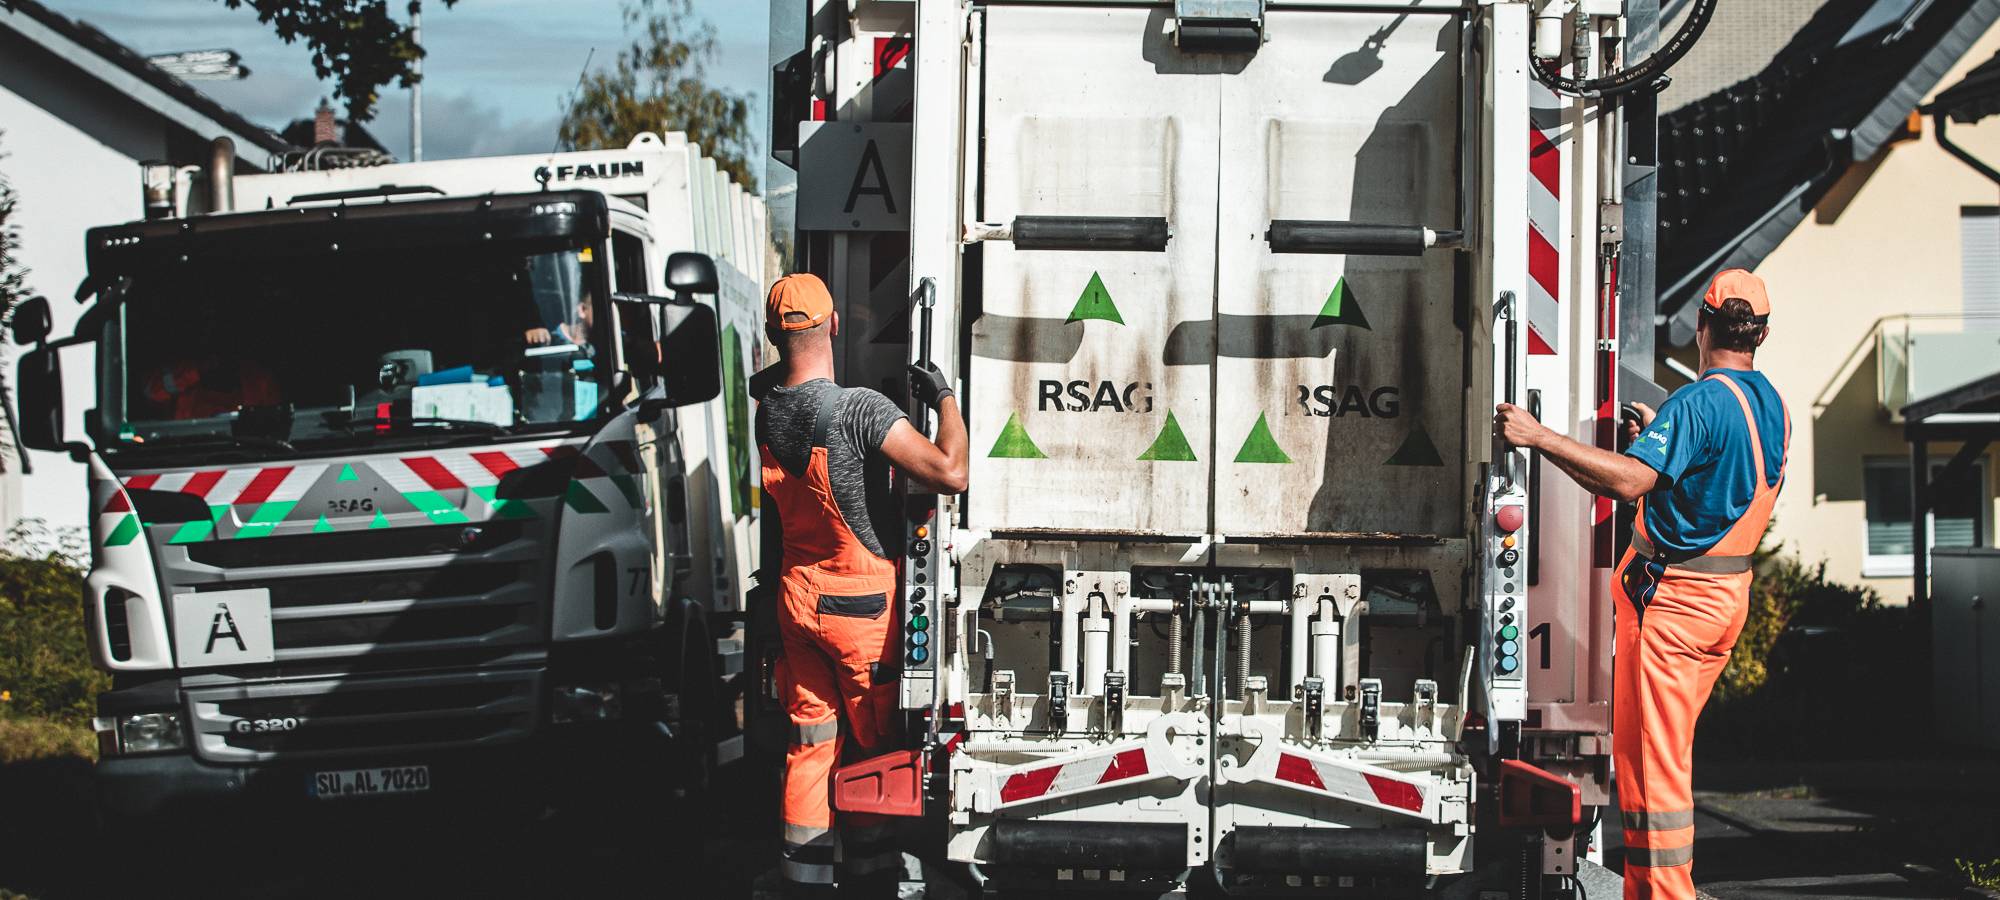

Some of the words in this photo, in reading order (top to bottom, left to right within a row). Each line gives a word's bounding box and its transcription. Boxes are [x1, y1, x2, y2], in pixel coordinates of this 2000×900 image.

[556, 160, 644, 181] FAUN
[843, 139, 897, 214] A
[1038, 380, 1153, 413] RSAG
[1647, 430, 1668, 445] RSAG
[205, 602, 247, 653] A
[1528, 622, 1551, 669] 1
[236, 720, 251, 733] G
[254, 717, 298, 733] 320
[317, 773, 341, 795] SU
[354, 771, 378, 793] AL
[381, 767, 429, 791] 7020
